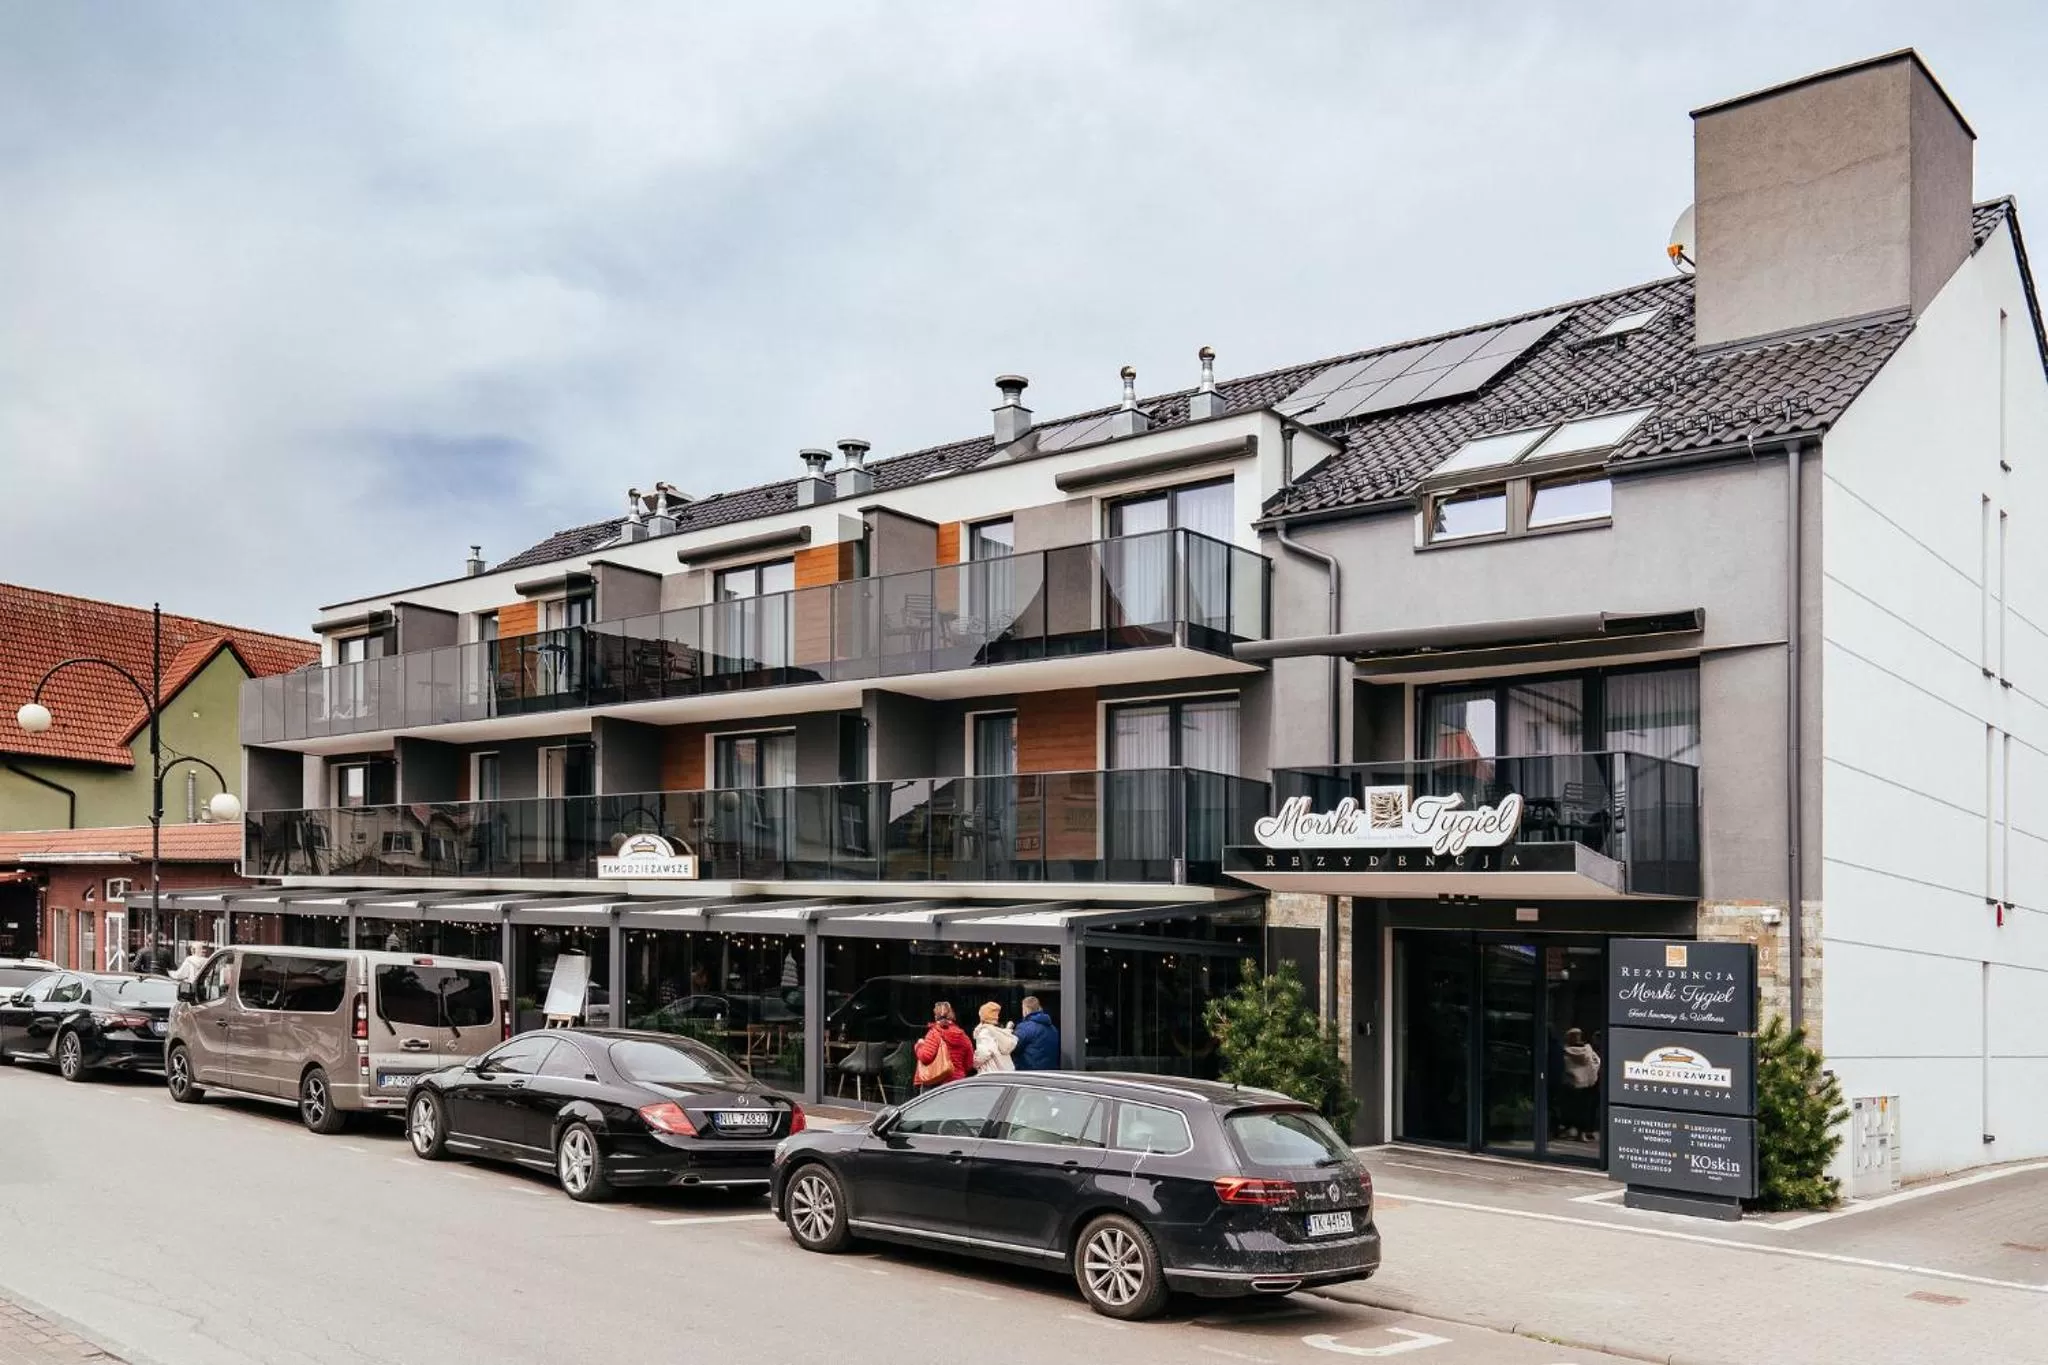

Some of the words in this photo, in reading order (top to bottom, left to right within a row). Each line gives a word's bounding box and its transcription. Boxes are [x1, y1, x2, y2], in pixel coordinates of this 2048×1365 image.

[1258, 797, 1358, 842] Morski
[1411, 795, 1519, 851] Tygiel
[603, 864, 689, 874] TAMGDZIEZAWSZE
[1266, 854, 1521, 869] REZYDENCJA
[1620, 966, 1735, 981] REZYDENCJA
[1618, 982, 1677, 1003] Morski
[1680, 985, 1736, 1010] Tygiel
[1628, 1067, 1727, 1082] TAMGDZIEZAWSZE
[1623, 1083, 1732, 1099] RESTAURACJA
[1691, 1154, 1740, 1172] KOskin
[1312, 1215, 1323, 1230] TK
